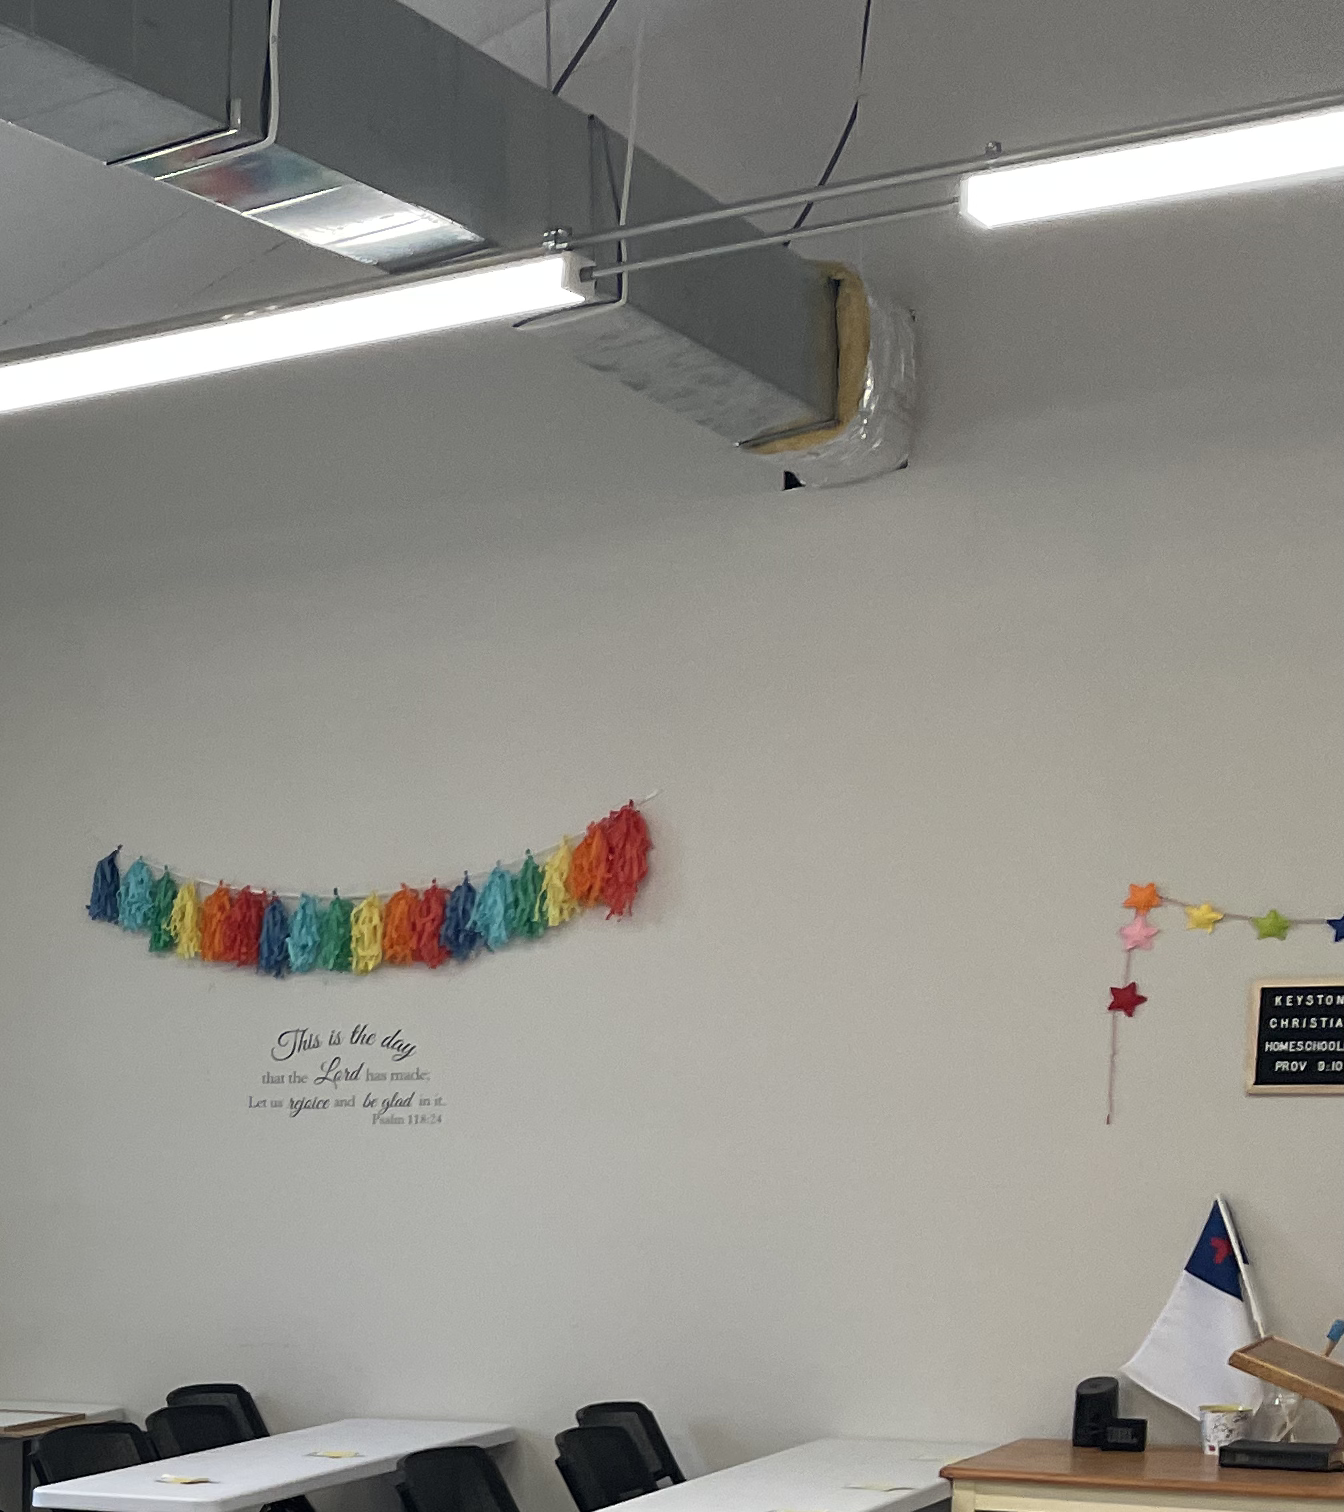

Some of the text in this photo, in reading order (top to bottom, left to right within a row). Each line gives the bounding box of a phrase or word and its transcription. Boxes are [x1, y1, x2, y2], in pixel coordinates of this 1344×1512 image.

[1269, 1017, 1343, 1029] CHRISTIA
[270, 1023, 417, 1062] This is the day
[262, 1071, 285, 1084] that
[288, 1070, 308, 1084] the
[313, 1056, 365, 1090] Lord
[366, 1067, 387, 1082] has
[1274, 1060, 1308, 1072] PROV
[248, 1095, 268, 1109] Let
[270, 1097, 284, 1109] us
[289, 1096, 330, 1118] rejoice
[333, 1094, 356, 1109] and
[362, 1091, 379, 1109] be
[380, 1091, 416, 1115] glad
[372, 1113, 405, 1125] Psalm
